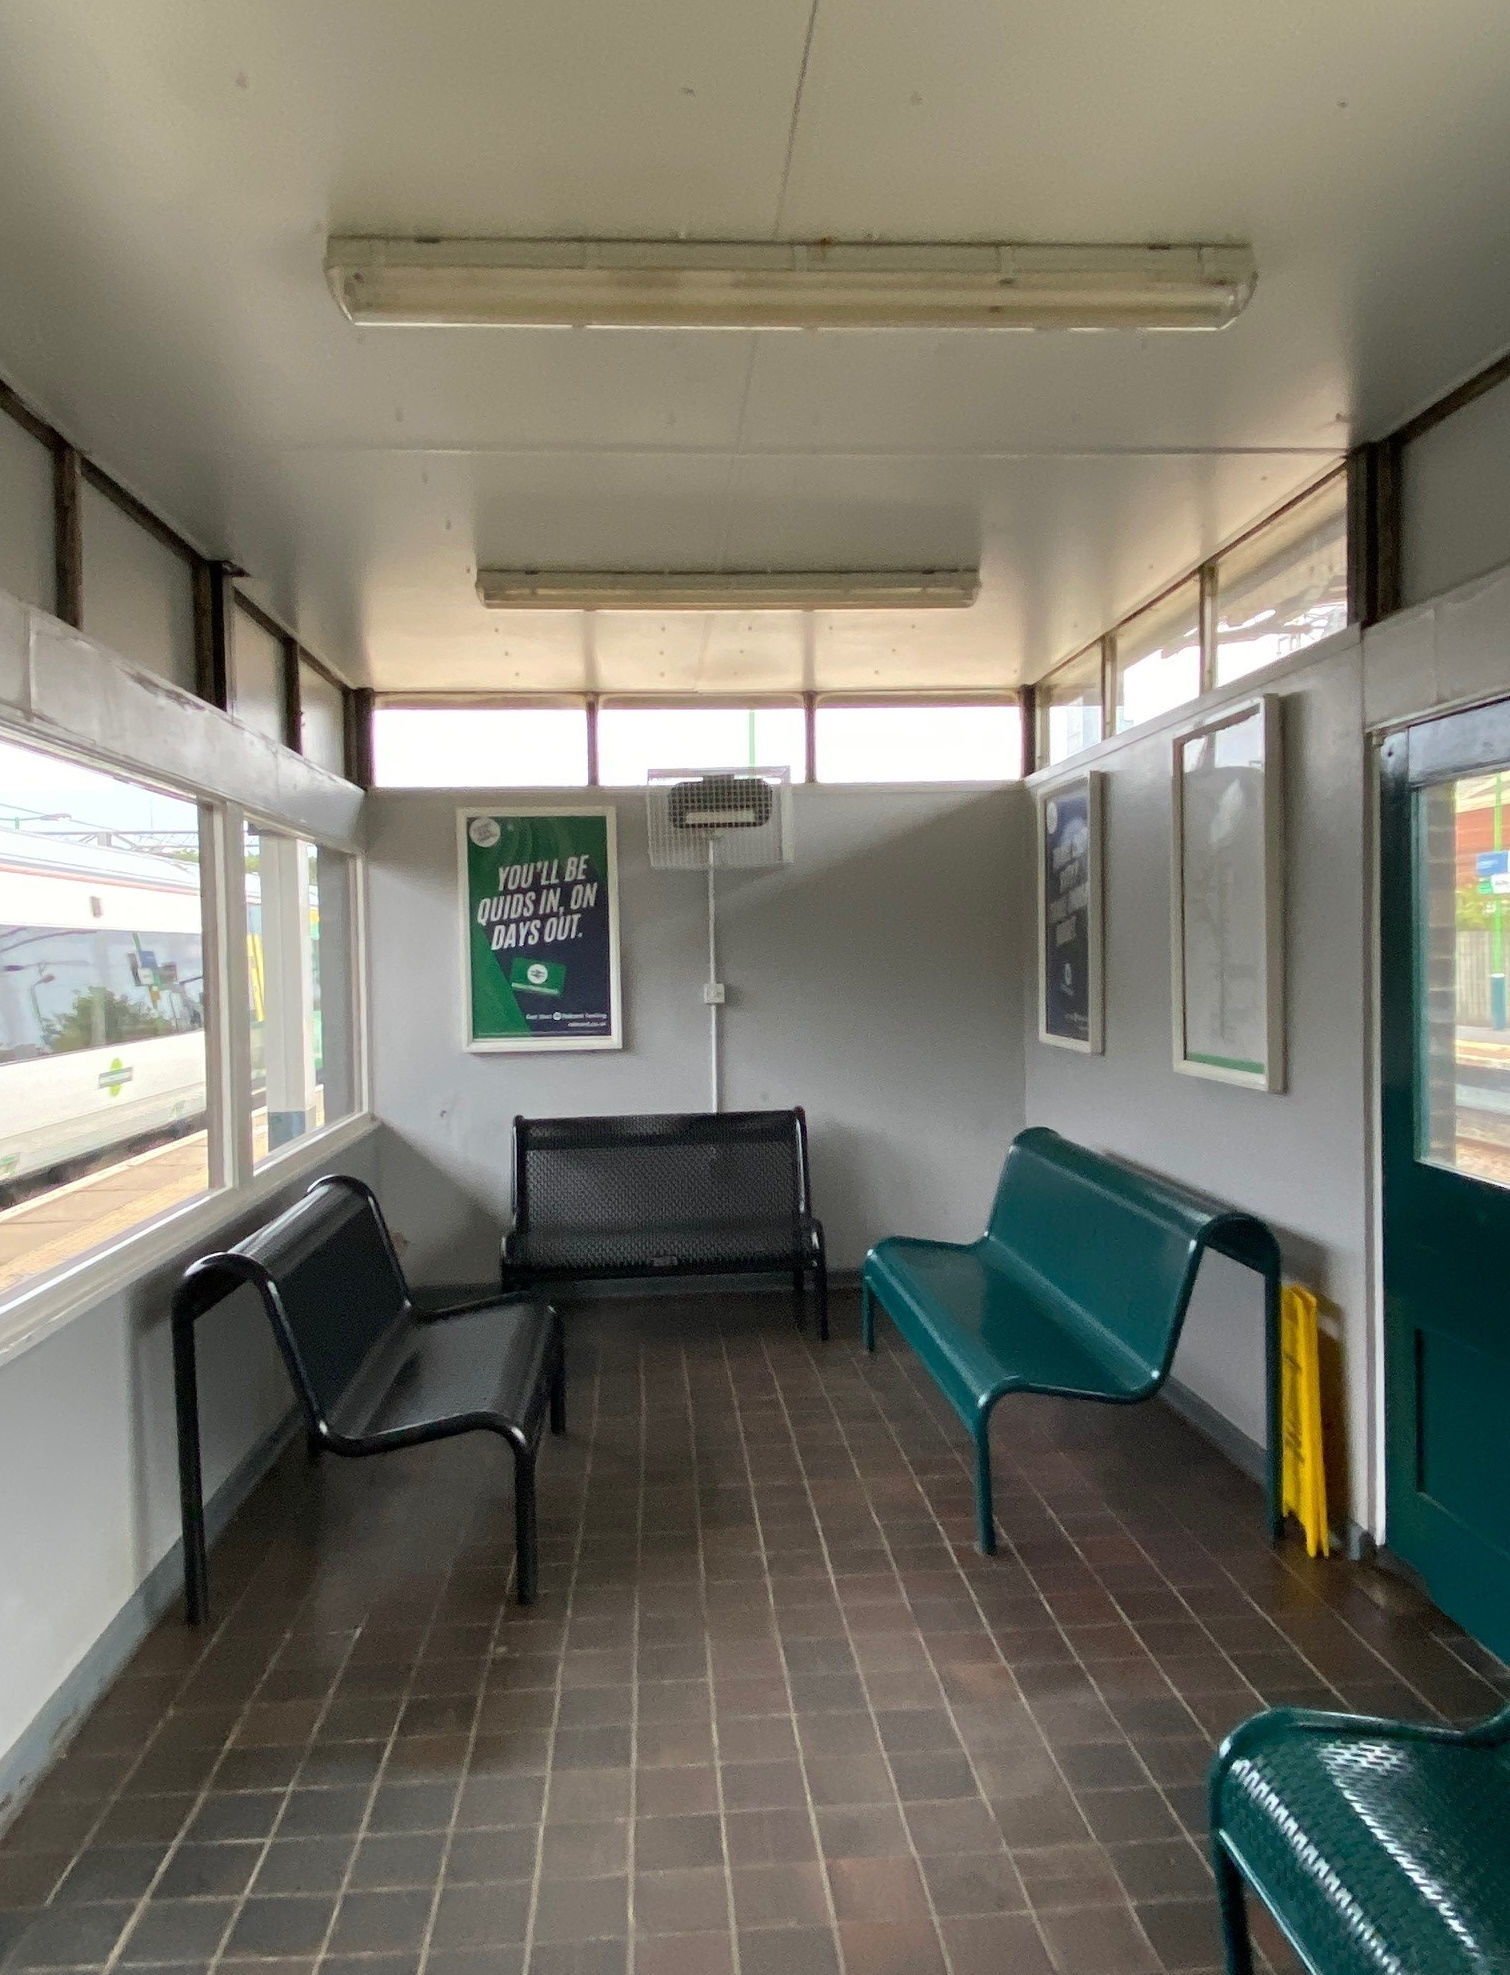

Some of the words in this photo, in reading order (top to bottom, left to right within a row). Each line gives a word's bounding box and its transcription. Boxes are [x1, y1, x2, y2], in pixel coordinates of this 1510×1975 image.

[498, 859, 559, 891] YOU'LL
[564, 854, 589, 882] BE
[477, 891, 536, 926] QUIDS
[538, 887, 564, 916] IN,
[570, 882, 598, 910] ON
[491, 919, 541, 951] DAYS
[543, 914, 583, 943] OUT.
